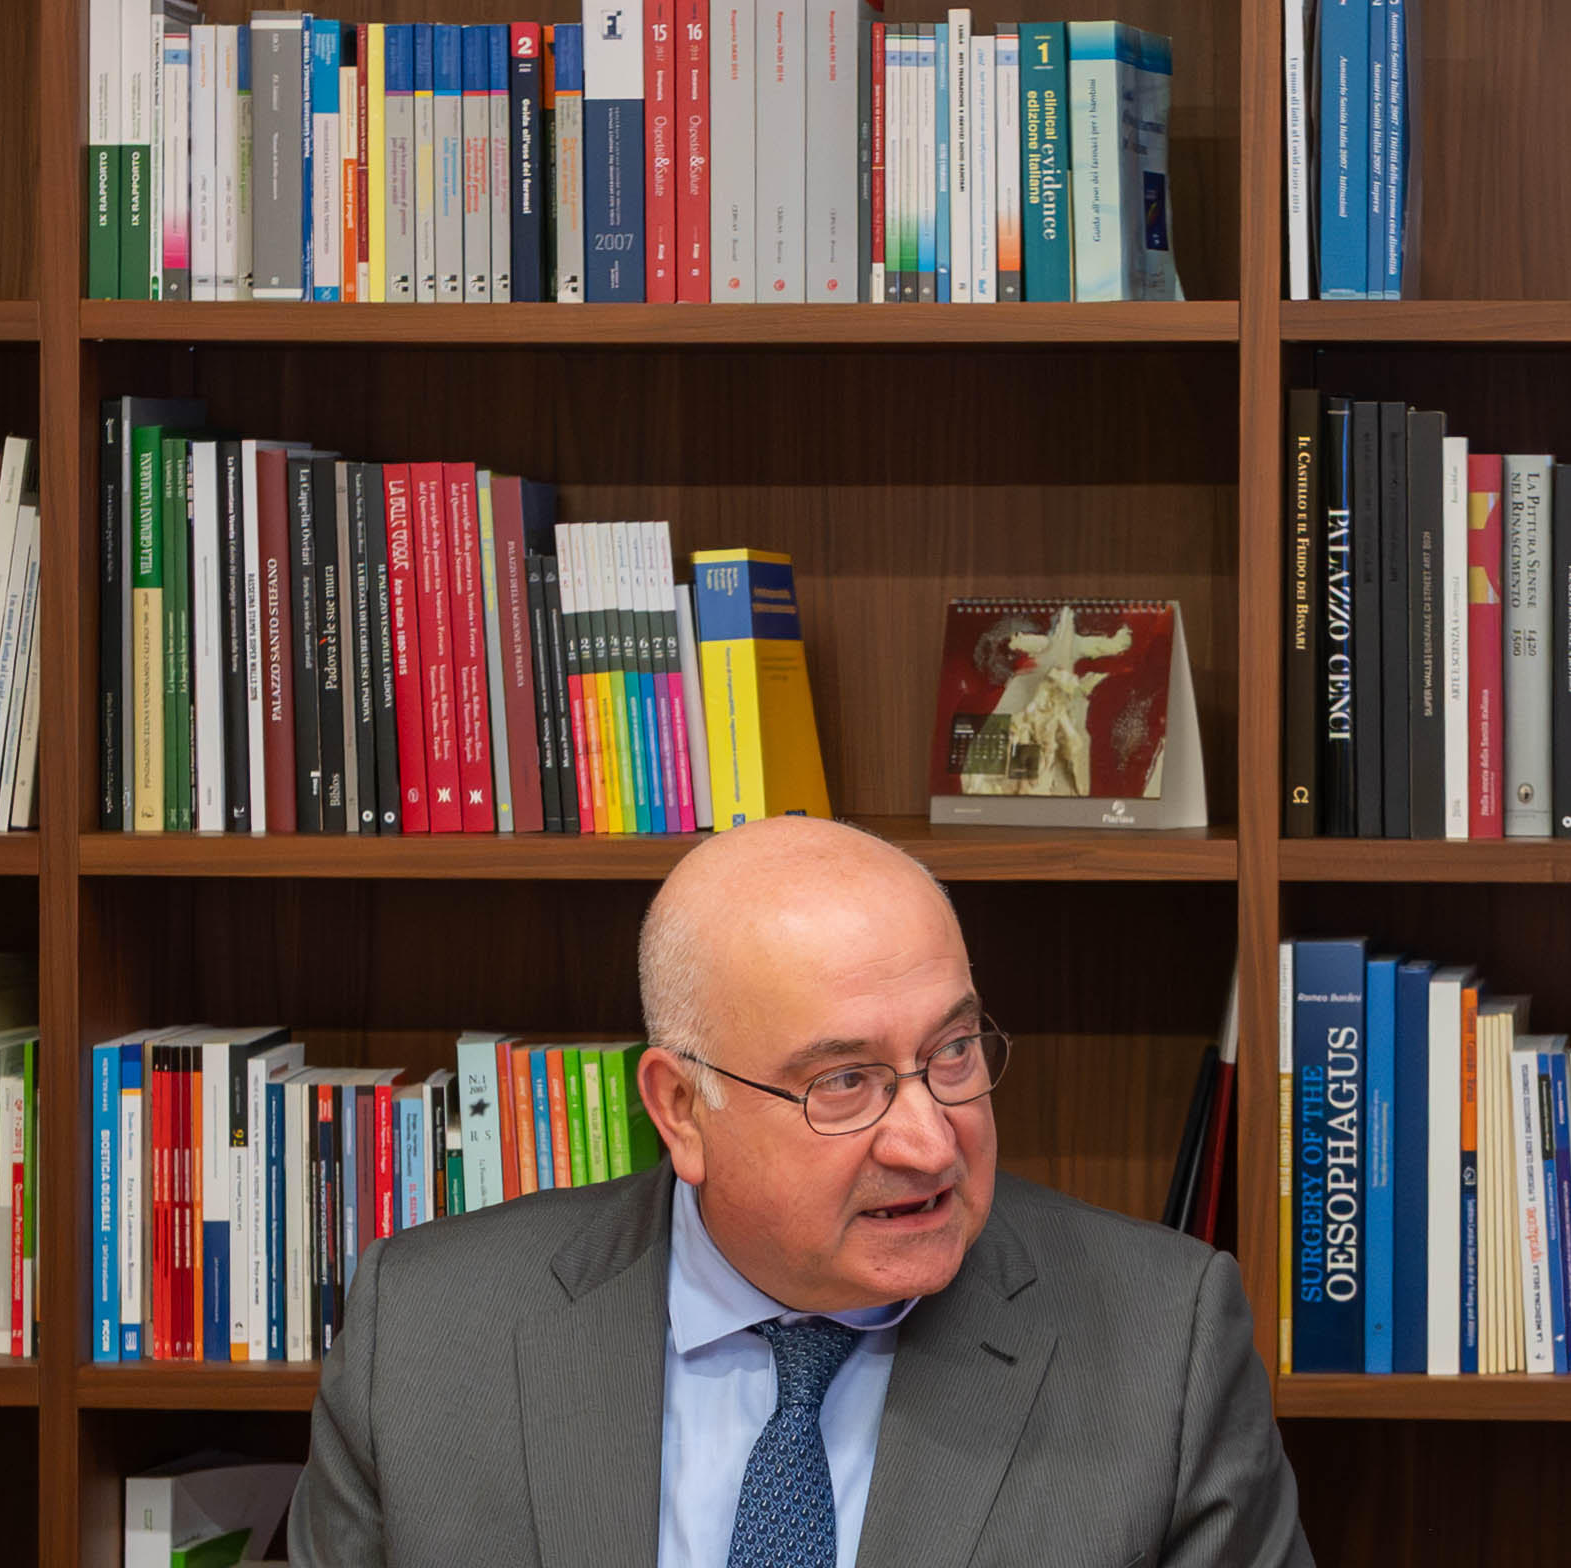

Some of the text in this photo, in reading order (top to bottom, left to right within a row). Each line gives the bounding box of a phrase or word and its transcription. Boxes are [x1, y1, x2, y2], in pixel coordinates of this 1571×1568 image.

[518, 37, 532, 54] 2
[652, 24, 666, 41] 15
[687, 24, 701, 40] 16
[1391, 12, 1399, 51] Annuario
[1339, 56, 1348, 95] Annuario
[1373, 62, 1382, 100] Annuario
[1390, 81, 1399, 103] Italia
[1026, 91, 1041, 149] edizione
[1339, 125, 1347, 147] Italia
[1373, 131, 1382, 153] Italia
[99, 152, 108, 211] RAPPORTO
[131, 152, 140, 211] RAPPORTO
[1028, 153, 1041, 203] italiana
[1042, 91, 1061, 240] clinical evidence
[594, 234, 633, 251] 2007
[1510, 472, 1524, 608] NEL RINASCIMENTO
[1526, 472, 1539, 609] LA PITTURA SENESE
[325, 566, 334, 598] mura
[267, 559, 282, 721] PALAZZO SANTO STEFANO
[1327, 507, 1350, 742] PALAZZO CENCI
[325, 645, 337, 689] Padova
[1300, 1065, 1324, 1303] SURGERY OF THE
[1326, 1026, 1358, 1301] OESOPHAGUS
